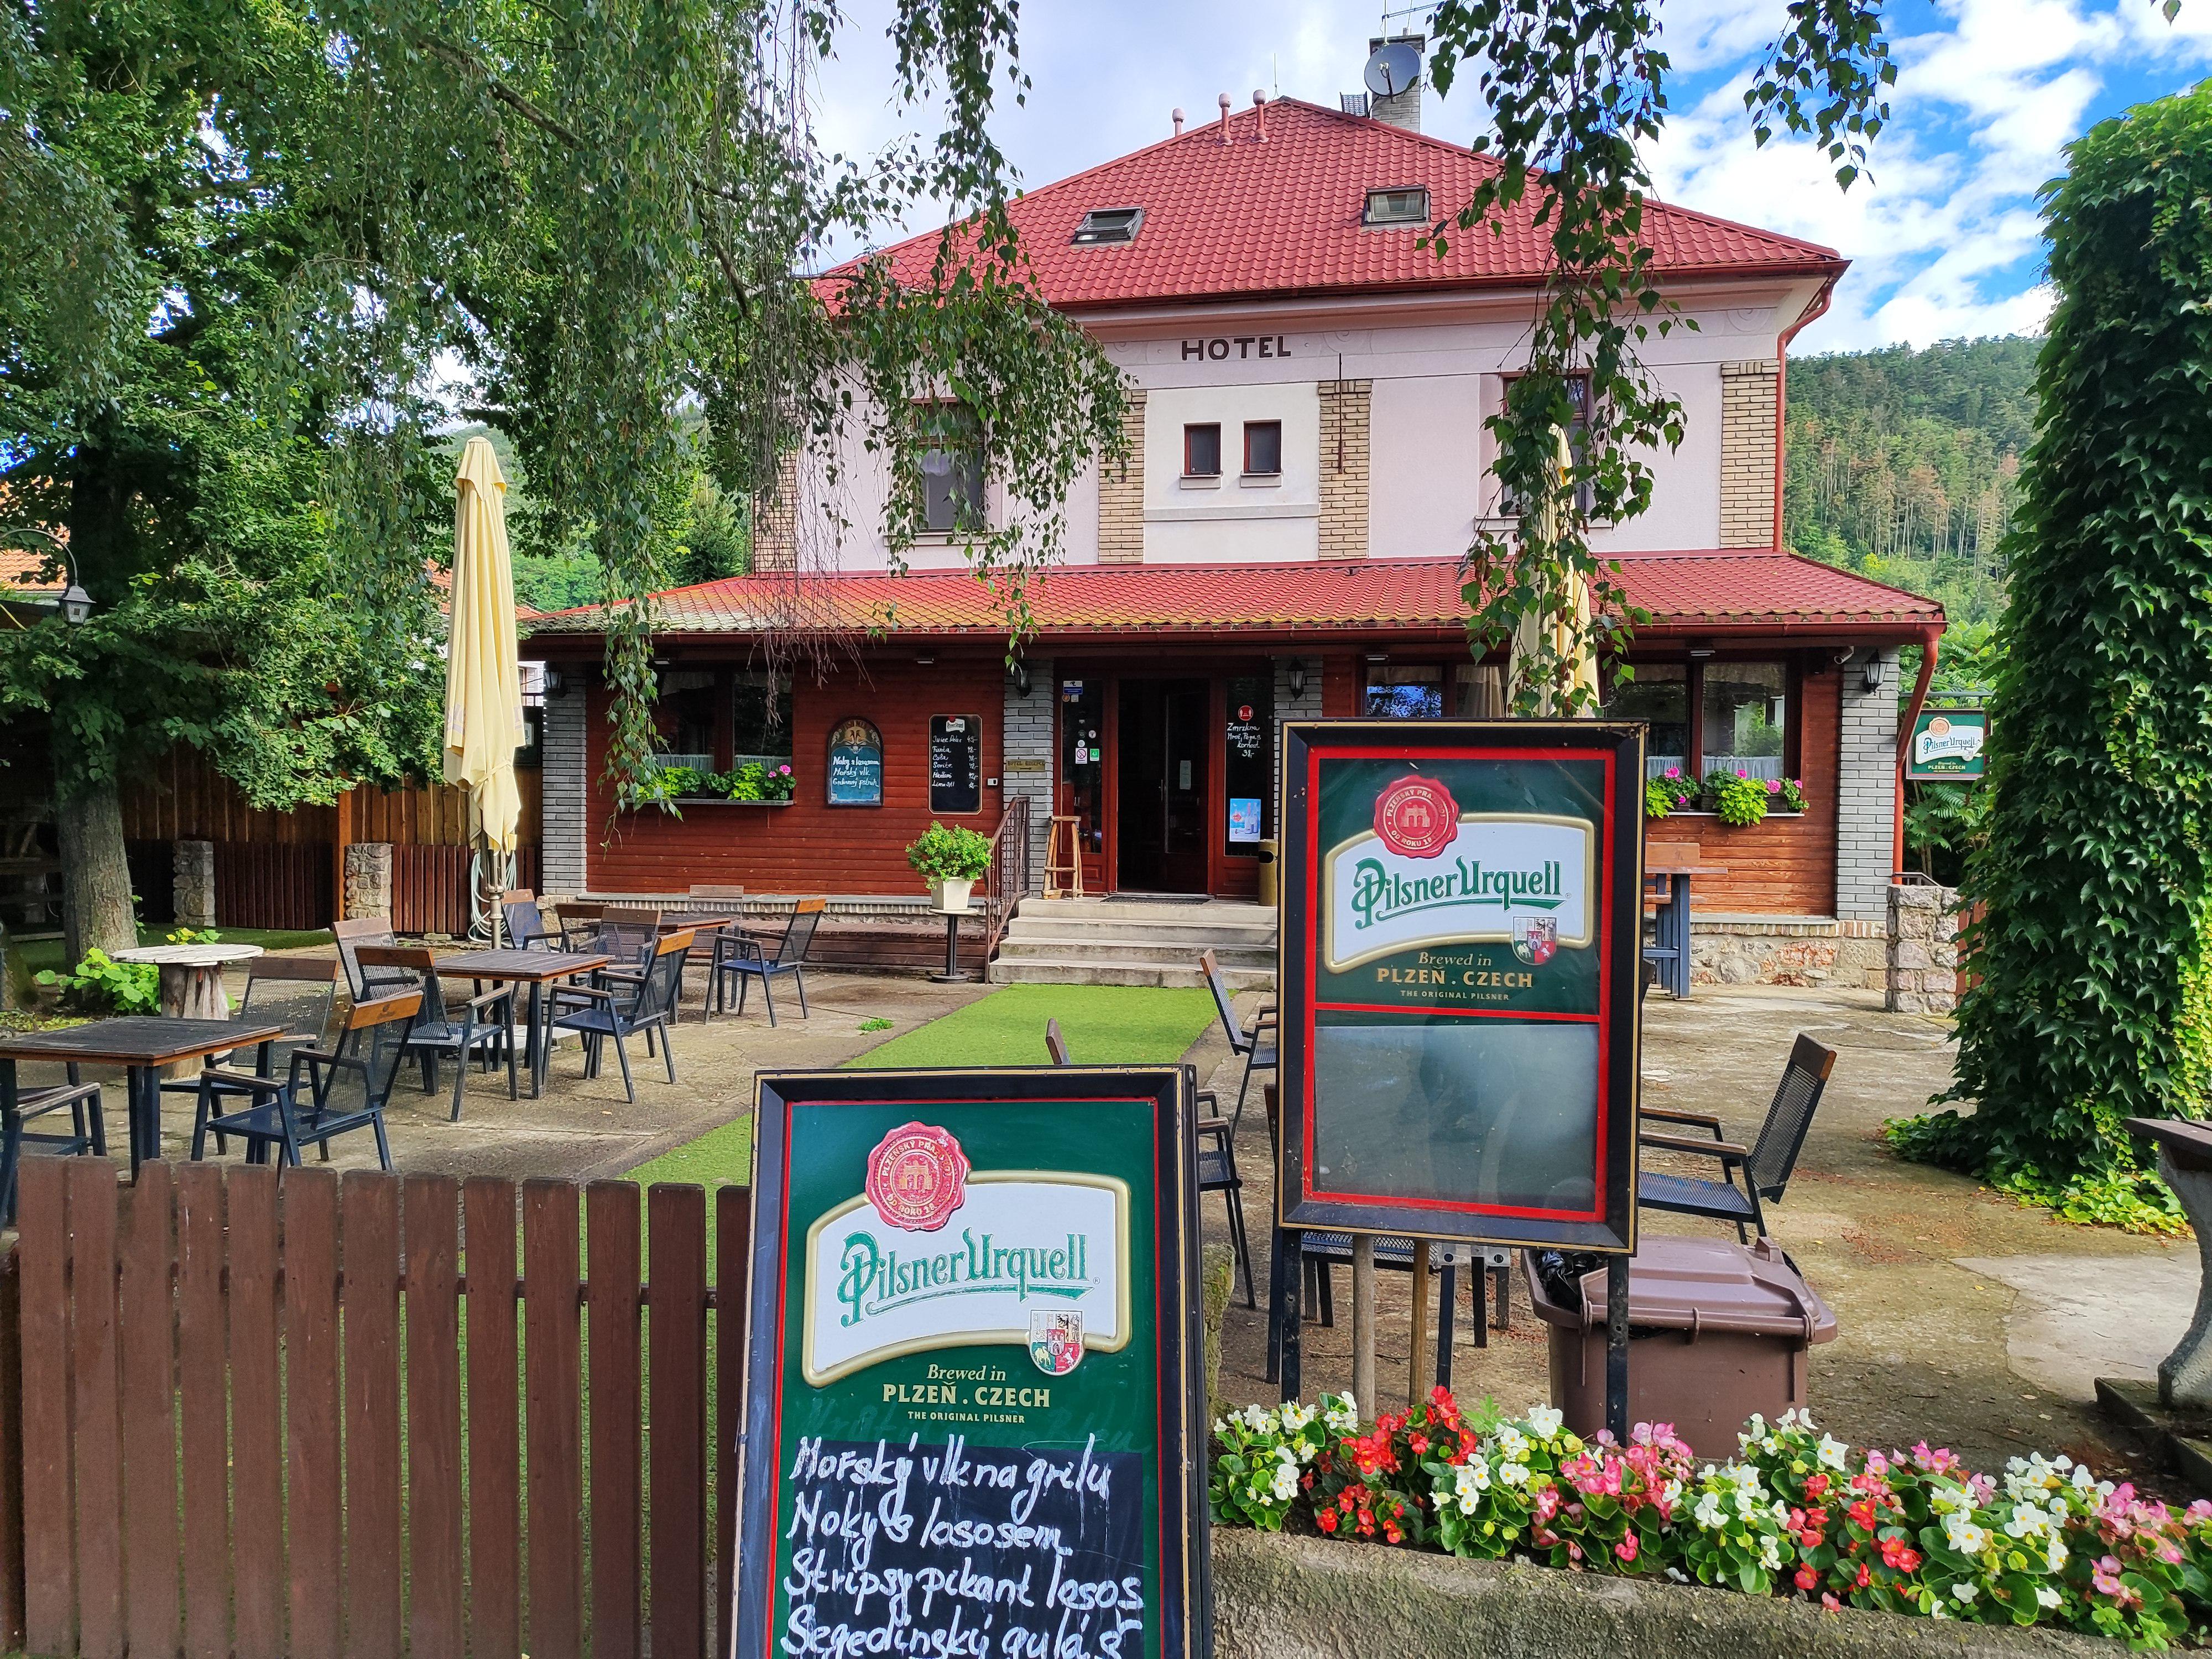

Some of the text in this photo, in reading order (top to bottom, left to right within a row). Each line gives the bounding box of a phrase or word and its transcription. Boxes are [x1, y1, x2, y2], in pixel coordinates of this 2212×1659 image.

[1181, 336, 1291, 361] HOTEL
[1923, 736, 1975, 754] Pilsner Urquell
[1391, 830, 1400, 839] OD
[1401, 838, 1422, 847] ROKU
[1351, 855, 1562, 930] Pilsner Urquell
[1418, 951, 1492, 967] Brewed in
[1376, 966, 1446, 985] PLZEŇ
[1463, 970, 1533, 988] CZECH
[1421, 990, 1467, 999] ORIGINAL
[886, 1193, 899, 1207] OD
[899, 1205, 923, 1215] ROKU
[837, 1227, 1089, 1328] Pilsner Urquell
[926, 1364, 1006, 1381] Brewed in
[883, 1381, 957, 1405] PLZEŇ
[974, 1386, 1051, 1408] CZECH
[907, 1411, 1026, 1423] THE ORIGINAL PILSNER
[922, 1433, 972, 1488] vlk
[973, 1463, 1018, 1489] na
[1010, 1432, 1112, 1526] grilu
[785, 1489, 879, 1573] Noky
[919, 1496, 1073, 1557] lososem
[915, 1557, 1035, 1618] pikant
[1046, 1553, 1146, 1610] losos
